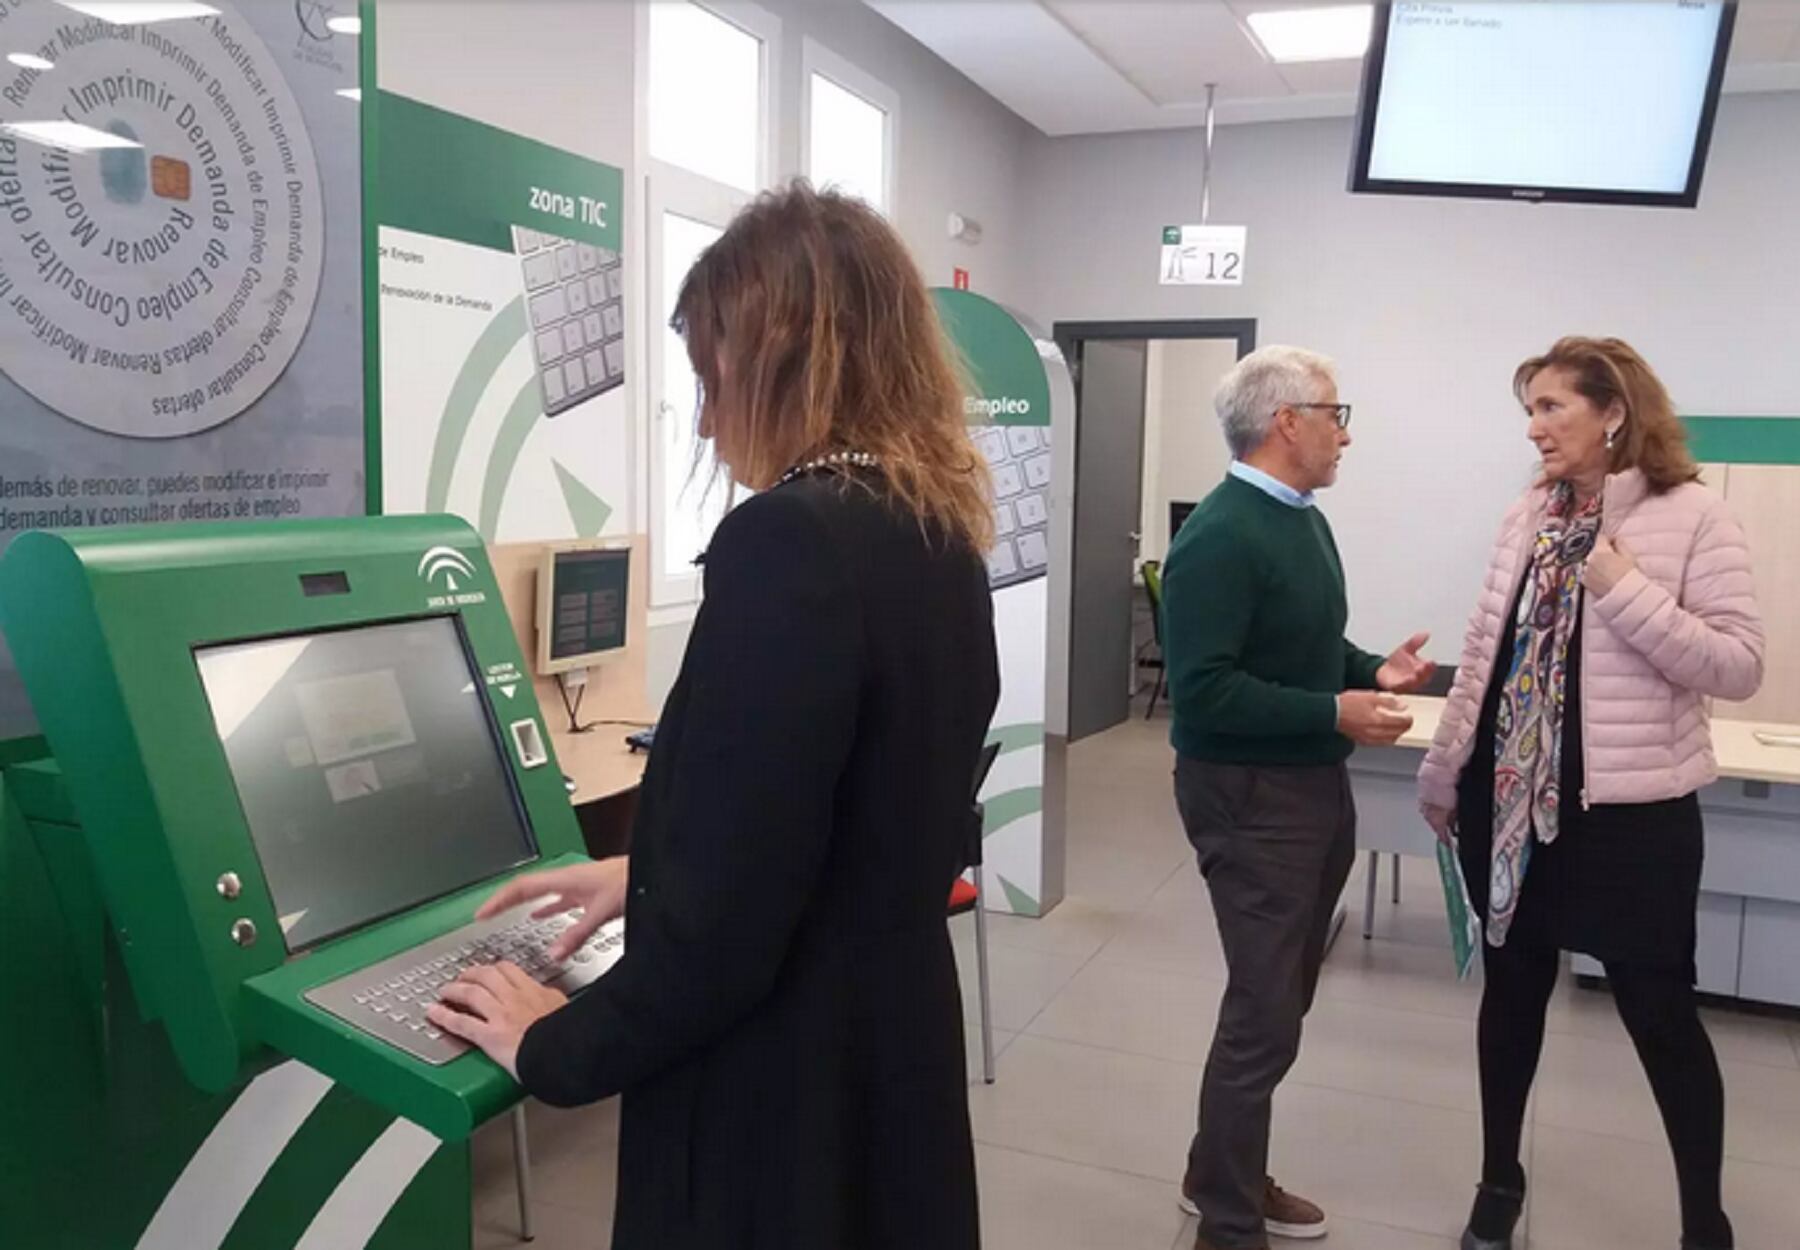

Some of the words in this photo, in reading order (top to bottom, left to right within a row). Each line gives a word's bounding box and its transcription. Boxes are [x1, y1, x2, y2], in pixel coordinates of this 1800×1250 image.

[2, 38, 60, 109] Renar
[68, 67, 176, 114] Imprimir
[205, 78, 256, 167] Demanda
[175, 103, 235, 232] Demanda
[247, 170, 264, 193] de
[286, 180, 304, 264] Demanda
[528, 186, 575, 219] zona
[578, 196, 607, 228] TIC
[101, 205, 195, 264] Renovar
[202, 237, 229, 269] de
[20, 230, 130, 328] Consultar
[282, 266, 299, 288] de
[1205, 252, 1241, 280] 12
[136, 267, 214, 322] Empleo
[213, 266, 262, 338] Consultar
[9, 294, 90, 365] Modificar
[207, 343, 267, 400] Consultar
[151, 388, 206, 416] ofertas
[965, 396, 1030, 418] Empleo
[57, 475, 78, 497] de
[203, 468, 265, 491] modificar
[267, 473, 277, 490] e
[278, 467, 330, 492] imprimir
[86, 506, 97, 526] y
[101, 500, 174, 525] consultar
[178, 498, 231, 521] ofertas
[234, 496, 250, 517] de
[253, 494, 300, 518] empleo
